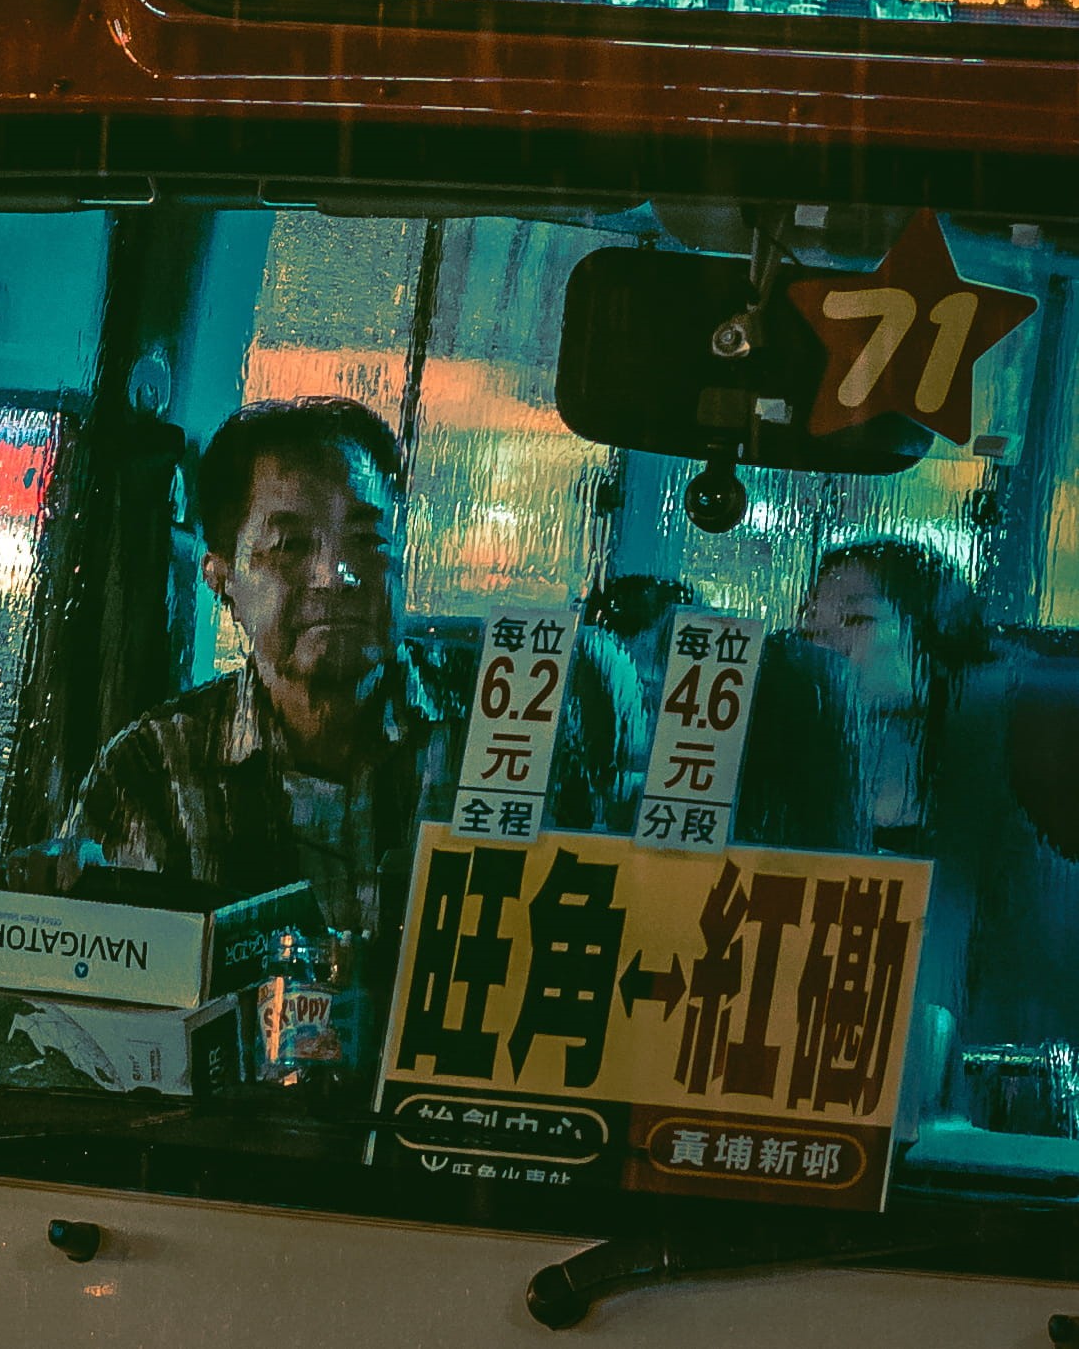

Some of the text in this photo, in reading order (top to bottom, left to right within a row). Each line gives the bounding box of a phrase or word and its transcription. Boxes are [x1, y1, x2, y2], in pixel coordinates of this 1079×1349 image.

[822, 287, 979, 414] 71
[491, 616, 567, 657] 每位
[674, 623, 752, 665] 每位
[480, 656, 561, 723] 6.2
[664, 665, 742, 732] 4.6
[481, 733, 533, 783] 元
[664, 741, 716, 792] 元
[458, 799, 533, 838] 全程
[642, 804, 719, 846] 分段
[396, 846, 913, 1117] 旺角 紅磡
[669, 1129, 842, 1180] 黃埔新邨
